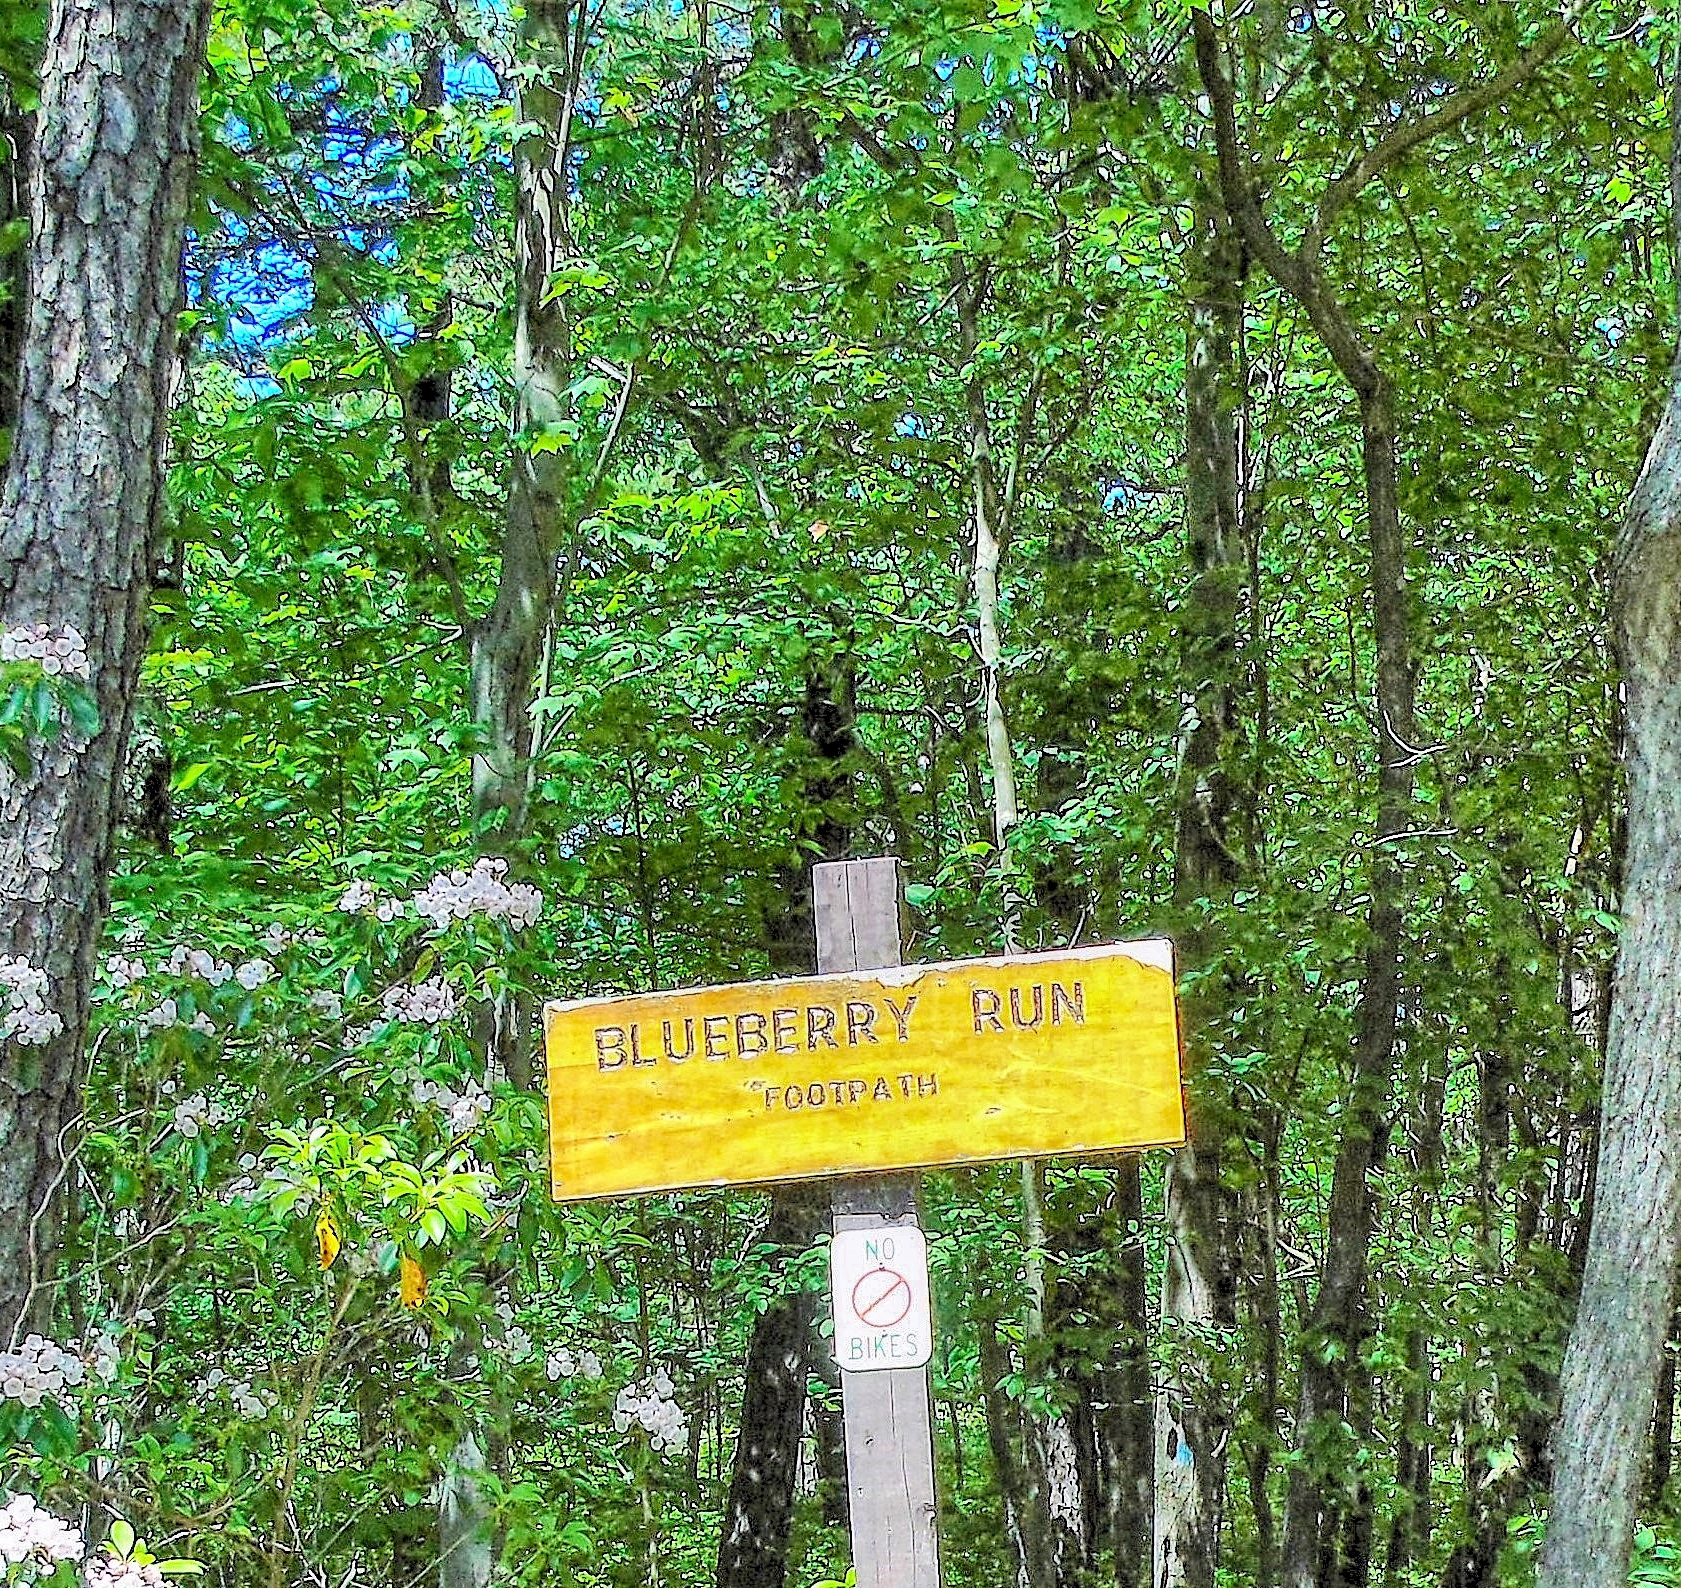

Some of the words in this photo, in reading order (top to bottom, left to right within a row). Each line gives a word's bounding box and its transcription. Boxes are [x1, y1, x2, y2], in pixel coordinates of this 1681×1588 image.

[594, 996, 917, 1073] BLUEBERRY
[972, 982, 1085, 1035] RUN
[764, 1074, 938, 1110] FOOTPATH
[865, 1237, 895, 1261] NO
[848, 1333, 918, 1360] BIKES
